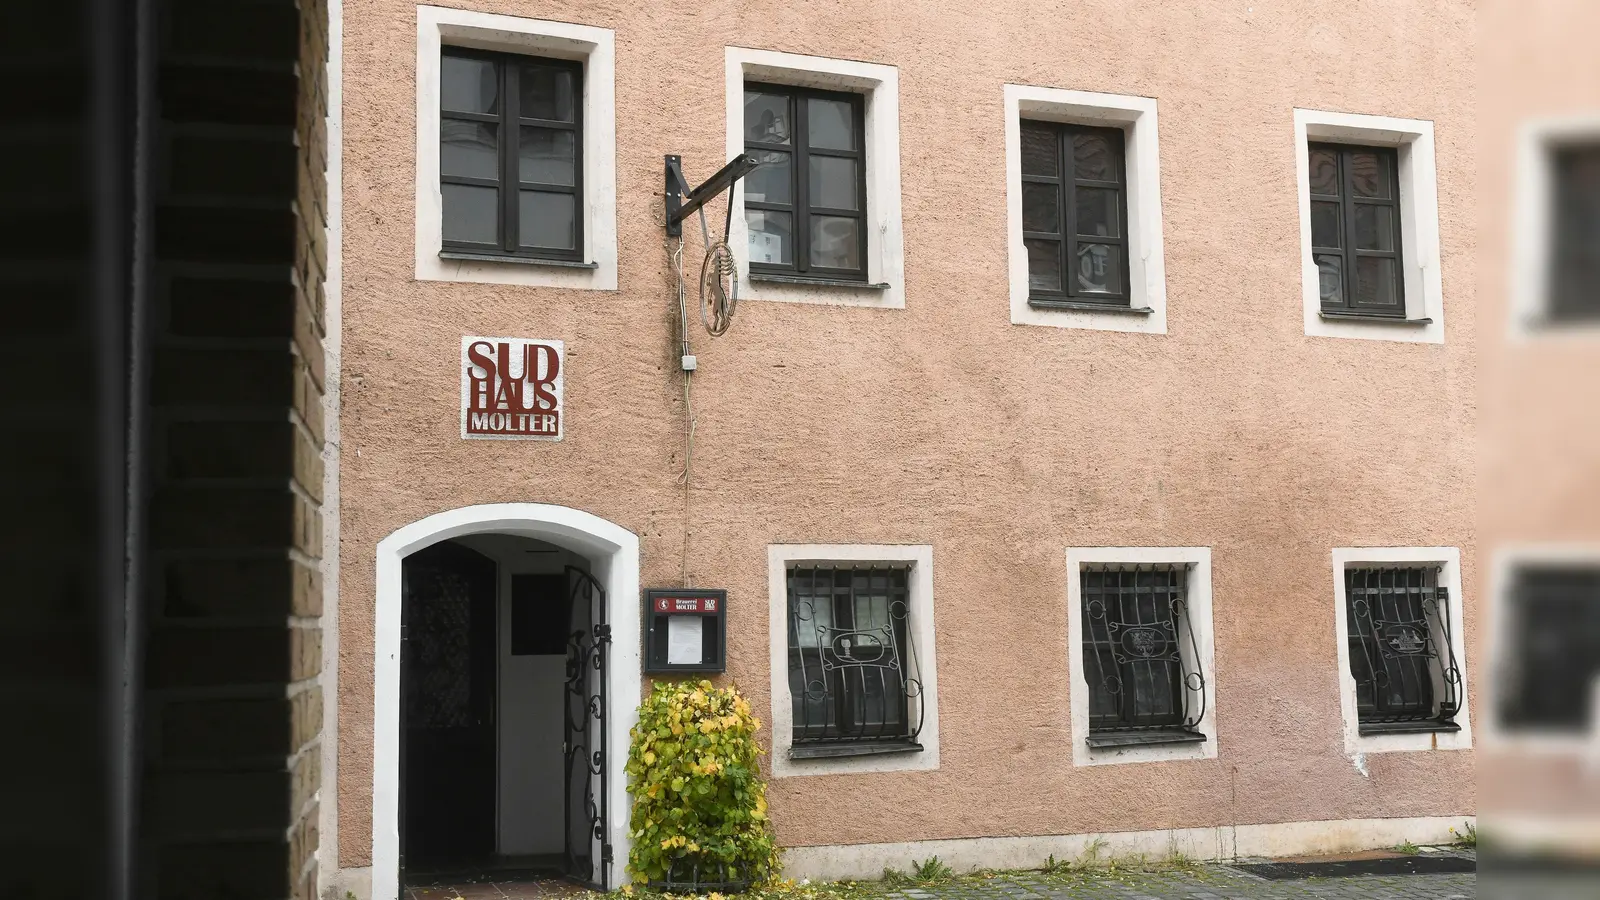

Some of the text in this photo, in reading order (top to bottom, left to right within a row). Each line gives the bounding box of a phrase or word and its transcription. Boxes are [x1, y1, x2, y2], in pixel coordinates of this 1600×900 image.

[467, 341, 559, 382] SUD
[470, 380, 558, 411] HAUS
[472, 412, 556, 432] MOLTER
